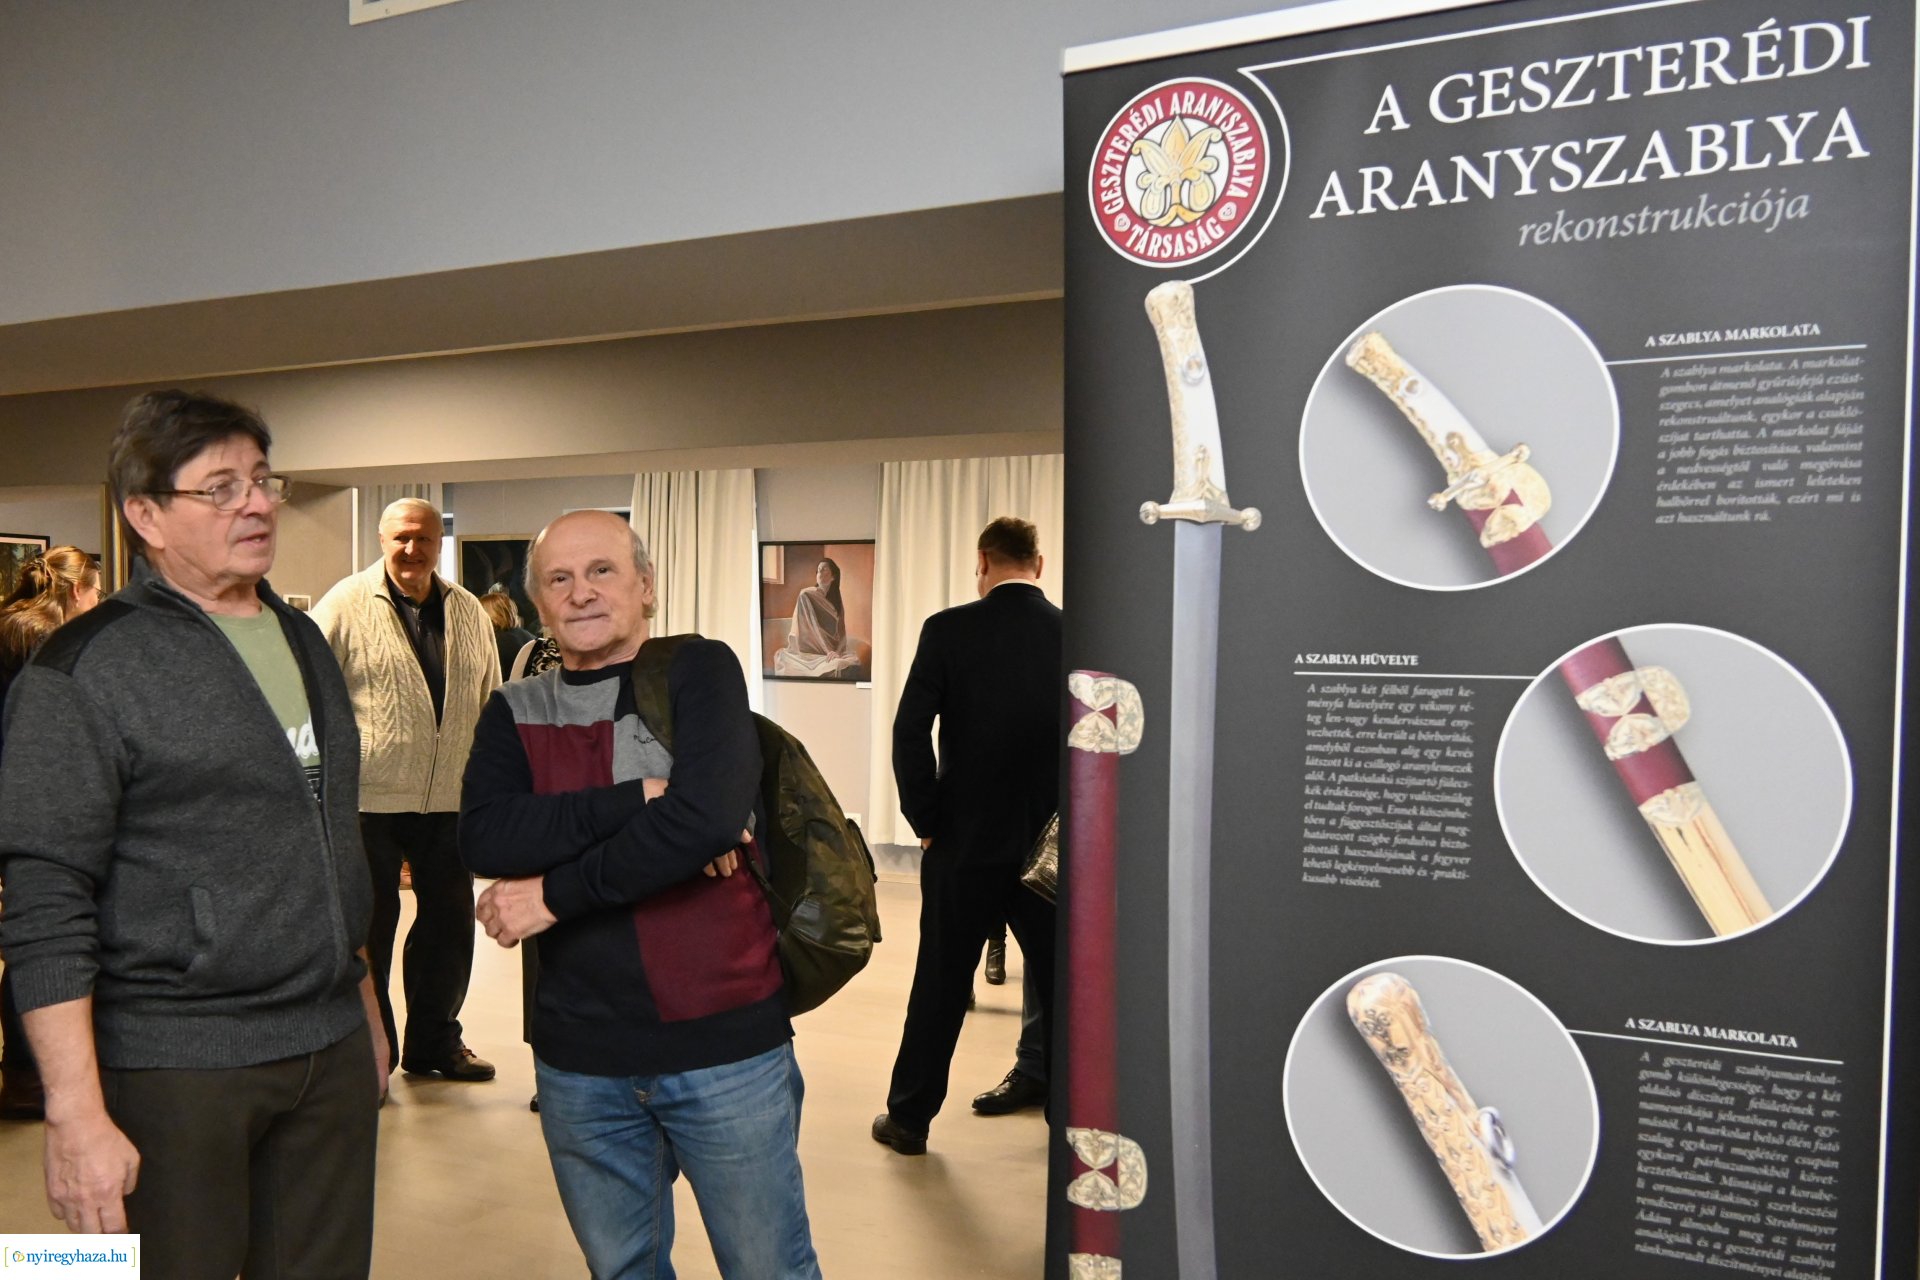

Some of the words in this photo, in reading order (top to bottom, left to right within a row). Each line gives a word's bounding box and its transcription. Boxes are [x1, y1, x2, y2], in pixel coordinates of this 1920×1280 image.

[1364, 84, 1410, 134] A
[1429, 15, 1872, 124] GESZTERÉDI
[1101, 97, 1164, 214] GESZTERÉDI
[1170, 91, 1256, 198] ARANYSZABLYA
[1309, 107, 1870, 219] ARANYSZABLYA
[1519, 188, 1810, 246] rekonstrukciója
[1125, 216, 1225, 258] TÁRSASÁG
[1645, 336, 1655, 348] A
[1659, 330, 1721, 346] SZABLYA
[1725, 323, 1820, 341] MARKOLATA
[1295, 654, 1304, 664] A
[1305, 653, 1358, 665] SZABLYA
[1360, 653, 1419, 666] HÜVELYE
[1307, 684, 1316, 692] A
[1344, 758, 1354, 767] ki
[1328, 772, 1336, 781] A
[1304, 800, 1314, 809] el
[1417, 867, 1428, 876] és
[1625, 1017, 1635, 1028] A
[1638, 1019, 1700, 1037] SZABLYA
[1703, 1026, 1798, 1048] MARKOLATA
